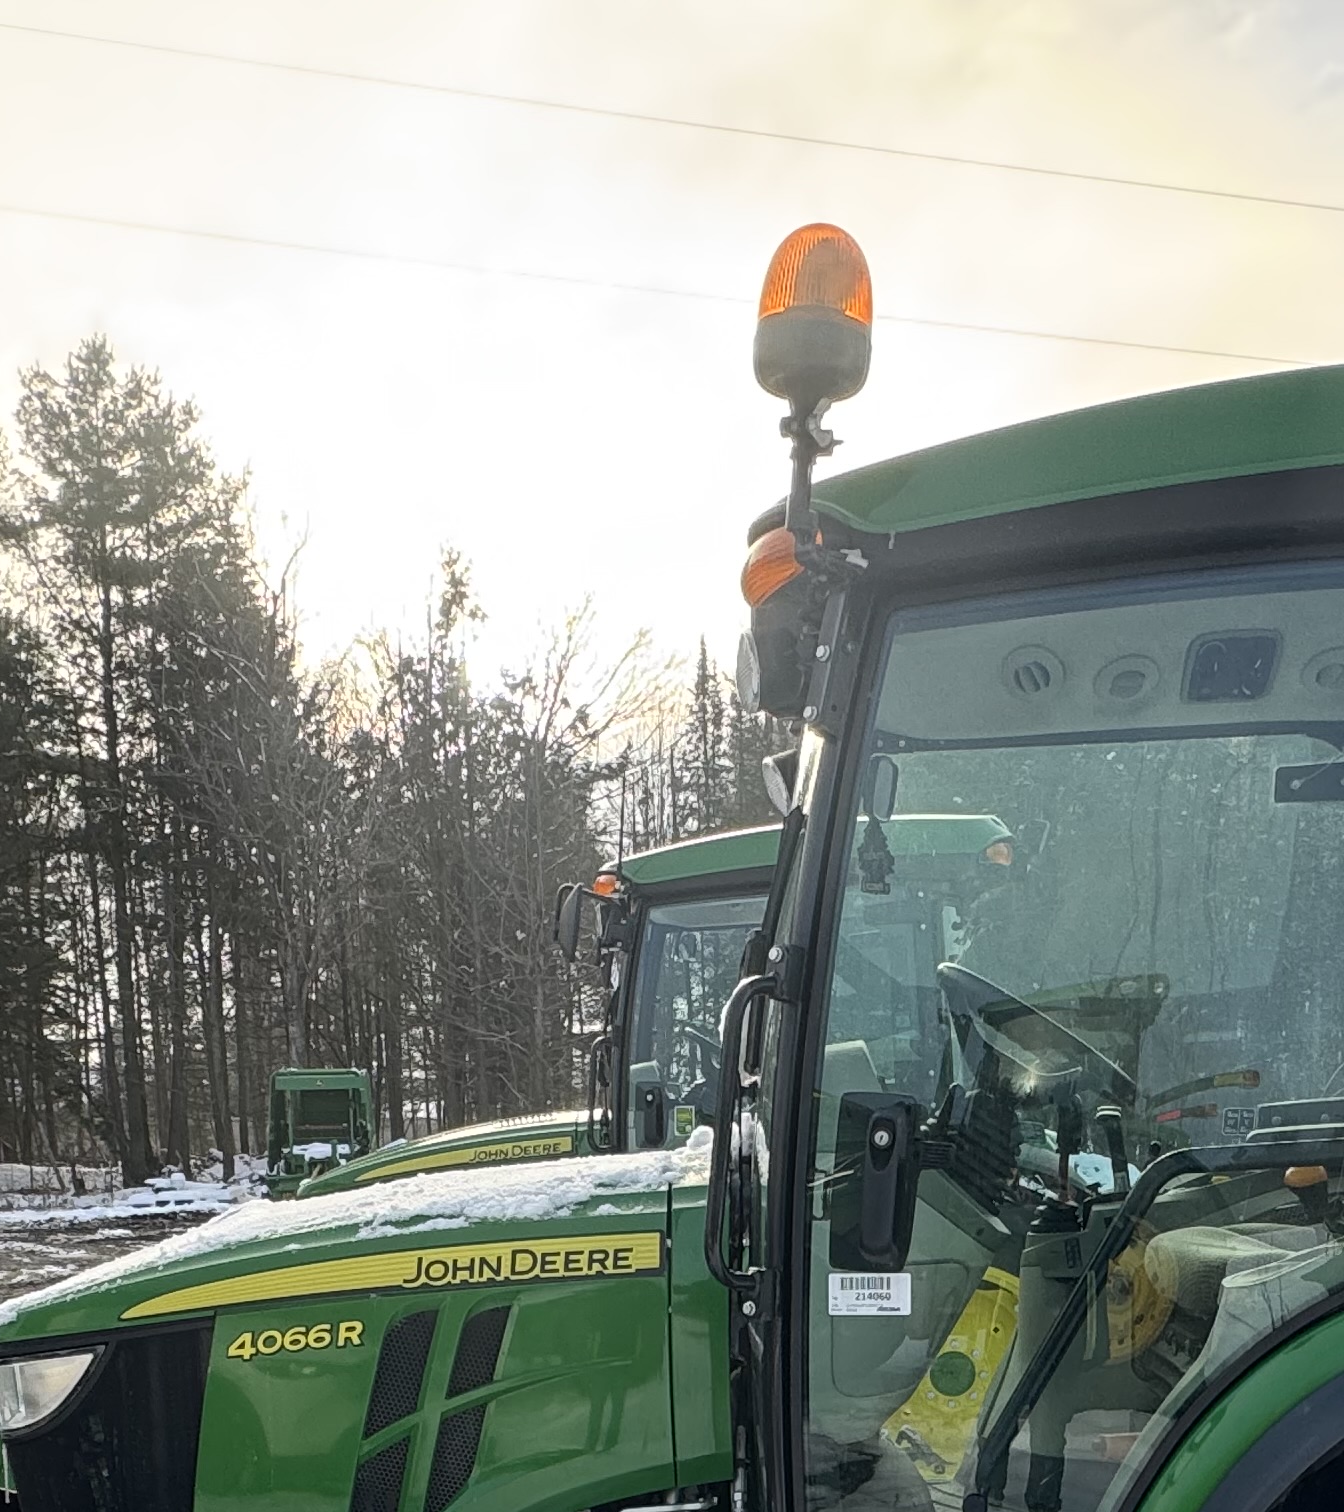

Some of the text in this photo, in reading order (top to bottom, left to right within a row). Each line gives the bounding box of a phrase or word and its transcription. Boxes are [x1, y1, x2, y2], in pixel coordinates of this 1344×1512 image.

[469, 1142, 562, 1162] JOHN DEERE
[403, 1247, 634, 1284] JOHN DEERE
[227, 1320, 364, 1360] 4066R
